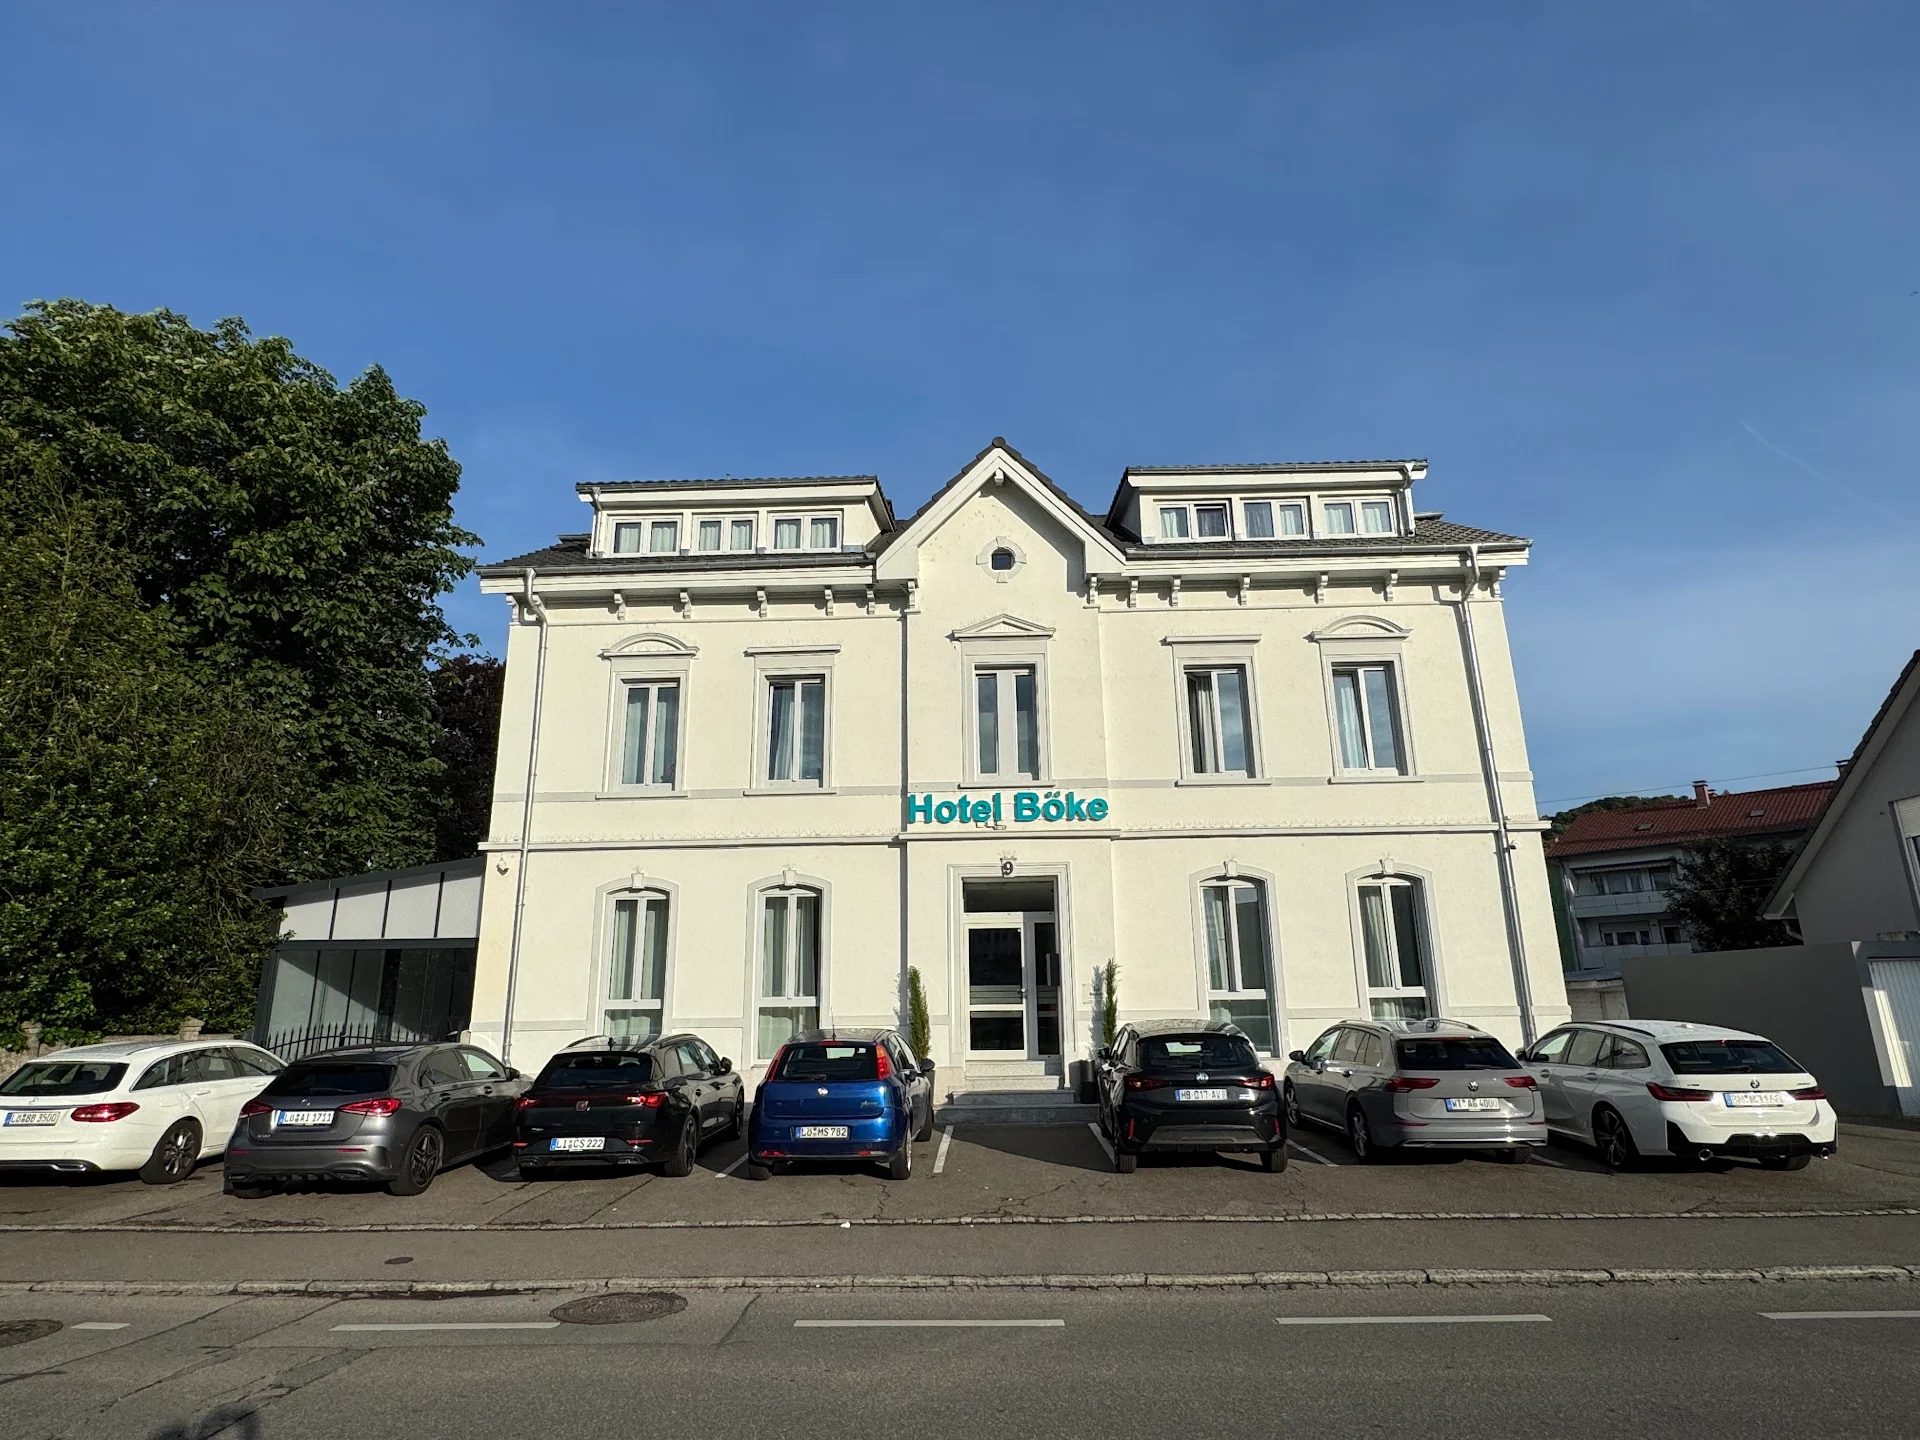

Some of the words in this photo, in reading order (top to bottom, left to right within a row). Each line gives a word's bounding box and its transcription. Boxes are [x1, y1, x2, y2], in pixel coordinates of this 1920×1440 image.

[907, 792, 1001, 824] Hotel
[1014, 791, 1109, 823] Böke
[1001, 860, 1014, 877] 9
[312, 1112, 332, 1122] 1711
[801, 1127, 812, 1137] LÖ
[817, 1127, 829, 1137] MS
[830, 1127, 847, 1137] 782
[556, 1139, 567, 1149] LI
[573, 1139, 585, 1149] CS
[586, 1138, 604, 1148] 222
